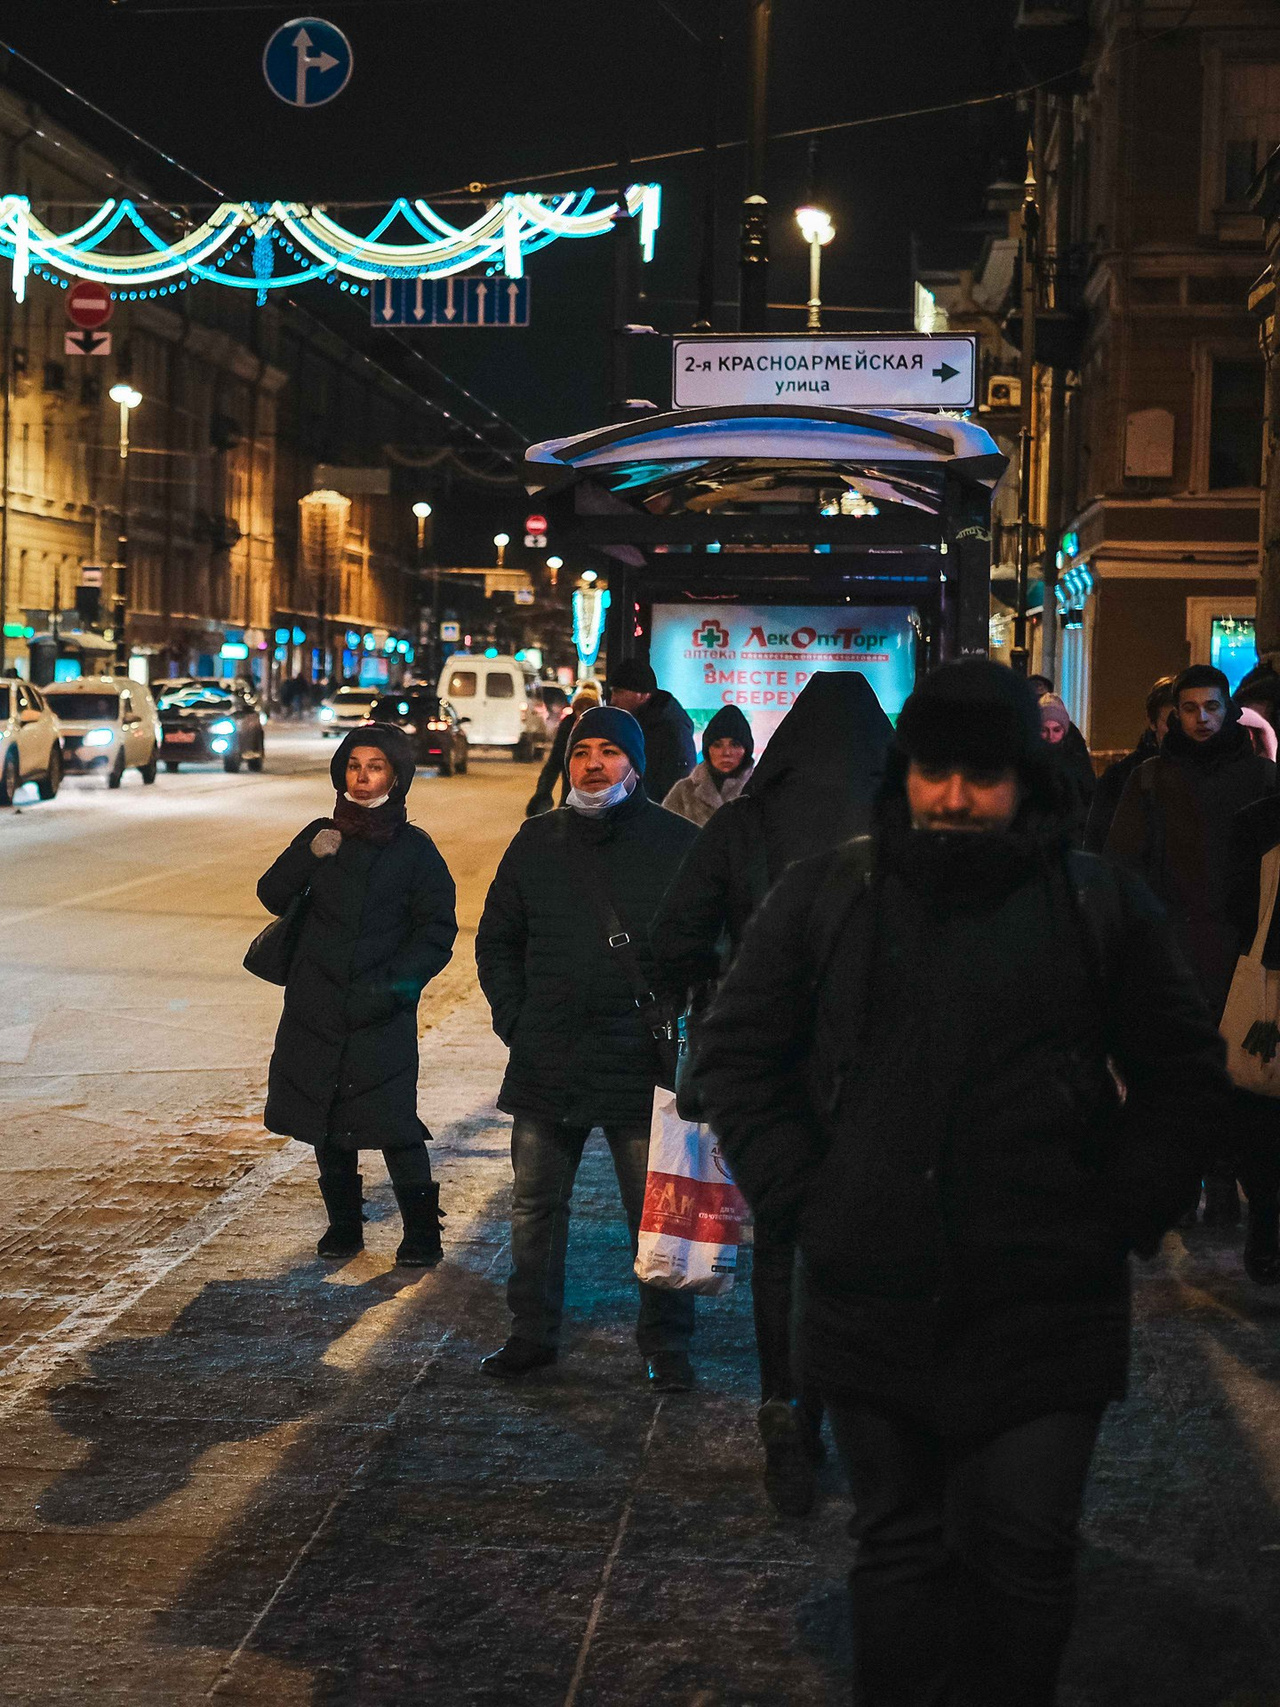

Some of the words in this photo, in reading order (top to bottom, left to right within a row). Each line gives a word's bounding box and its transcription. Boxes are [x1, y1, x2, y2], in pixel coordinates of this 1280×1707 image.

[685, 356, 712, 372] 2-я
[718, 350, 923, 372] КРАСНОАРМЕЙСКАЯ
[775, 379, 830, 396] улица
[704, 669, 787, 686] ВМЕСТЕ
